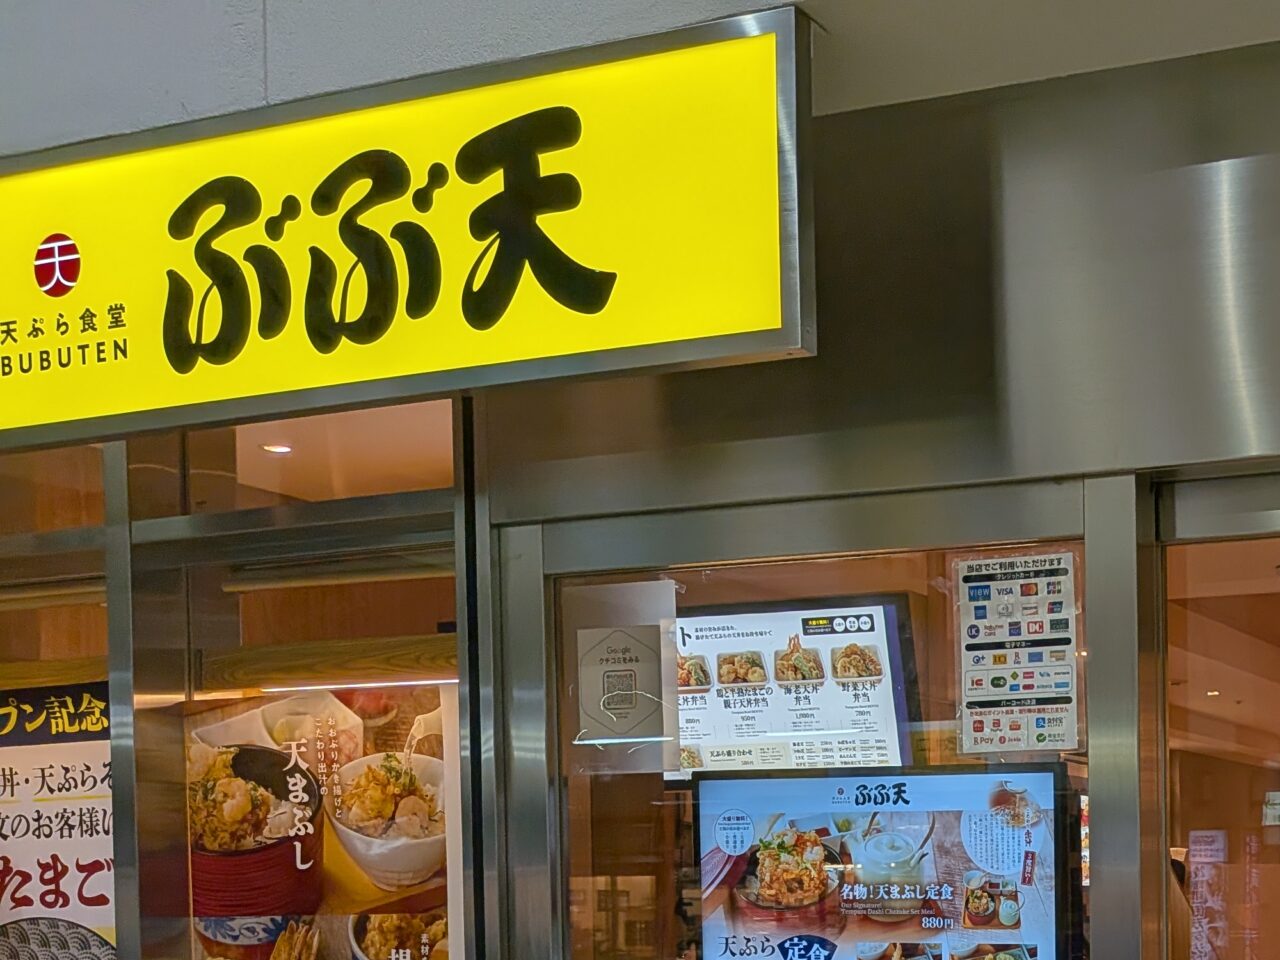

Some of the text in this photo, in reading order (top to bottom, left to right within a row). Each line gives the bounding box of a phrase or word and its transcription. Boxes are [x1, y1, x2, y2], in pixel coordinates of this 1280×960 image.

[163, 105, 617, 375] ぶぶ天
[0, 303, 127, 346] 天ぷら食堂
[1, 338, 128, 377] BUBUTEN
[966, 557, 1063, 574] 当店でご利用いただけます
[794, 695, 811, 706] 弁当
[853, 692, 870, 703] 弁当
[282, 738, 314, 871] 天まぶし
[855, 782, 910, 806] ぶぶ天
[922, 917, 954, 929] 880円
[718, 935, 776, 958] 天ぷら
